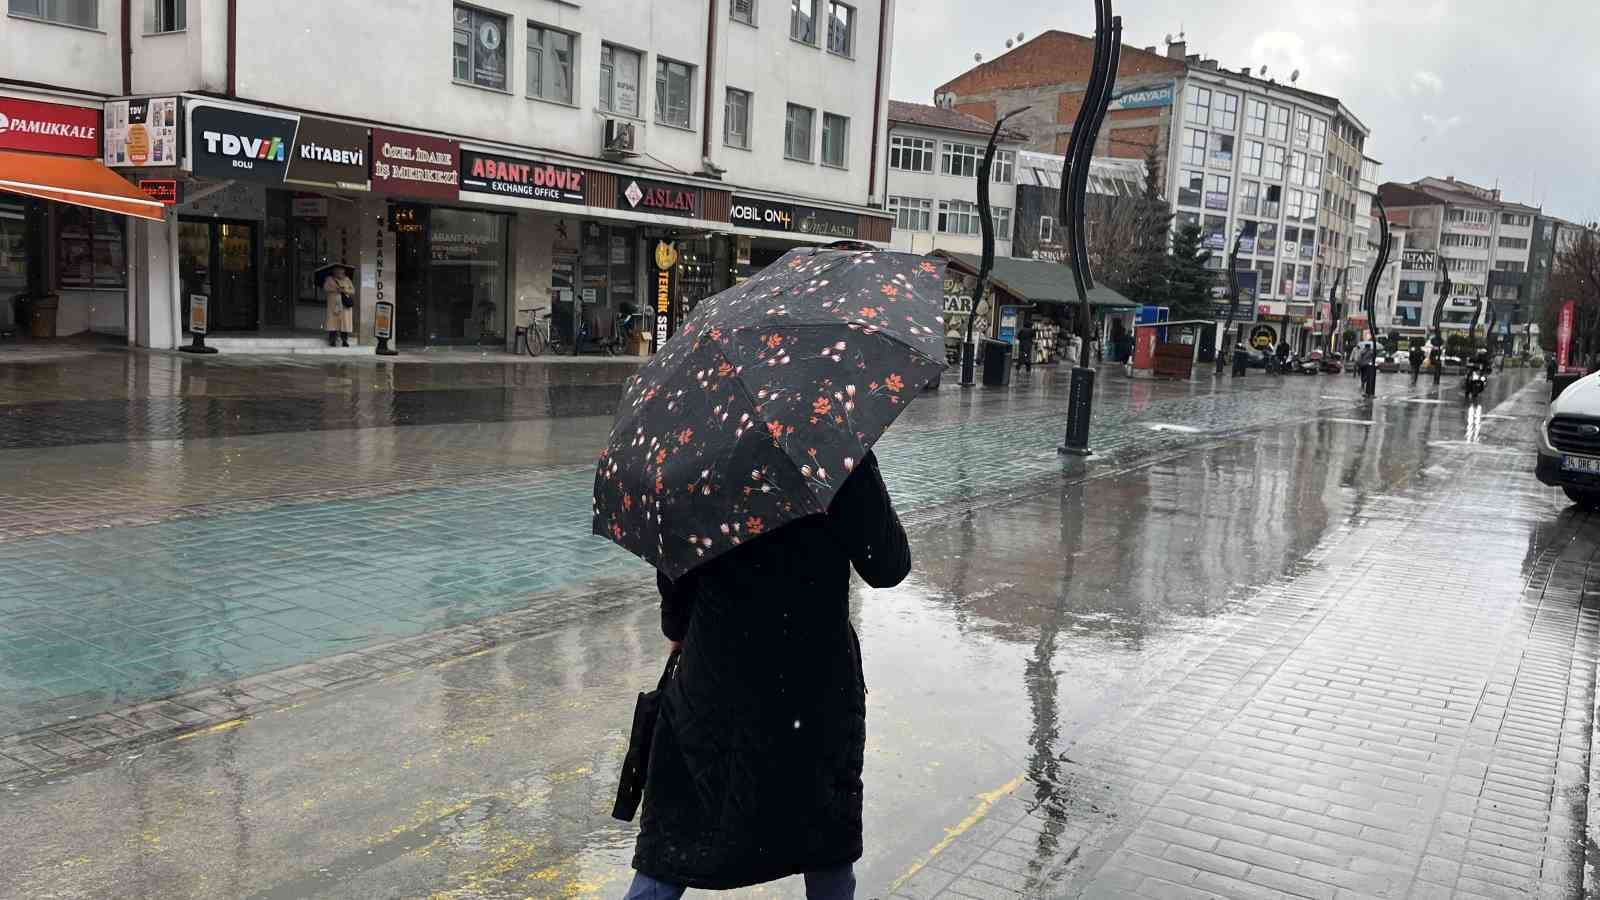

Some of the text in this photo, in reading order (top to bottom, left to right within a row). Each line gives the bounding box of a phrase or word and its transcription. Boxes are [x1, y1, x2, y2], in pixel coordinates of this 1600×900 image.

[10, 118, 96, 139] PAMUKKALE
[203, 131, 263, 159] TDV
[382, 142, 452, 165] ÖZEL İDARE
[232, 159, 253, 169] BOLU
[375, 160, 458, 185] İŞ MERKEZİ
[472, 158, 582, 191] ABANT DÖVİZ
[492, 181, 560, 199] EXCHANGE OFFICE
[644, 186, 696, 211] ASLAN
